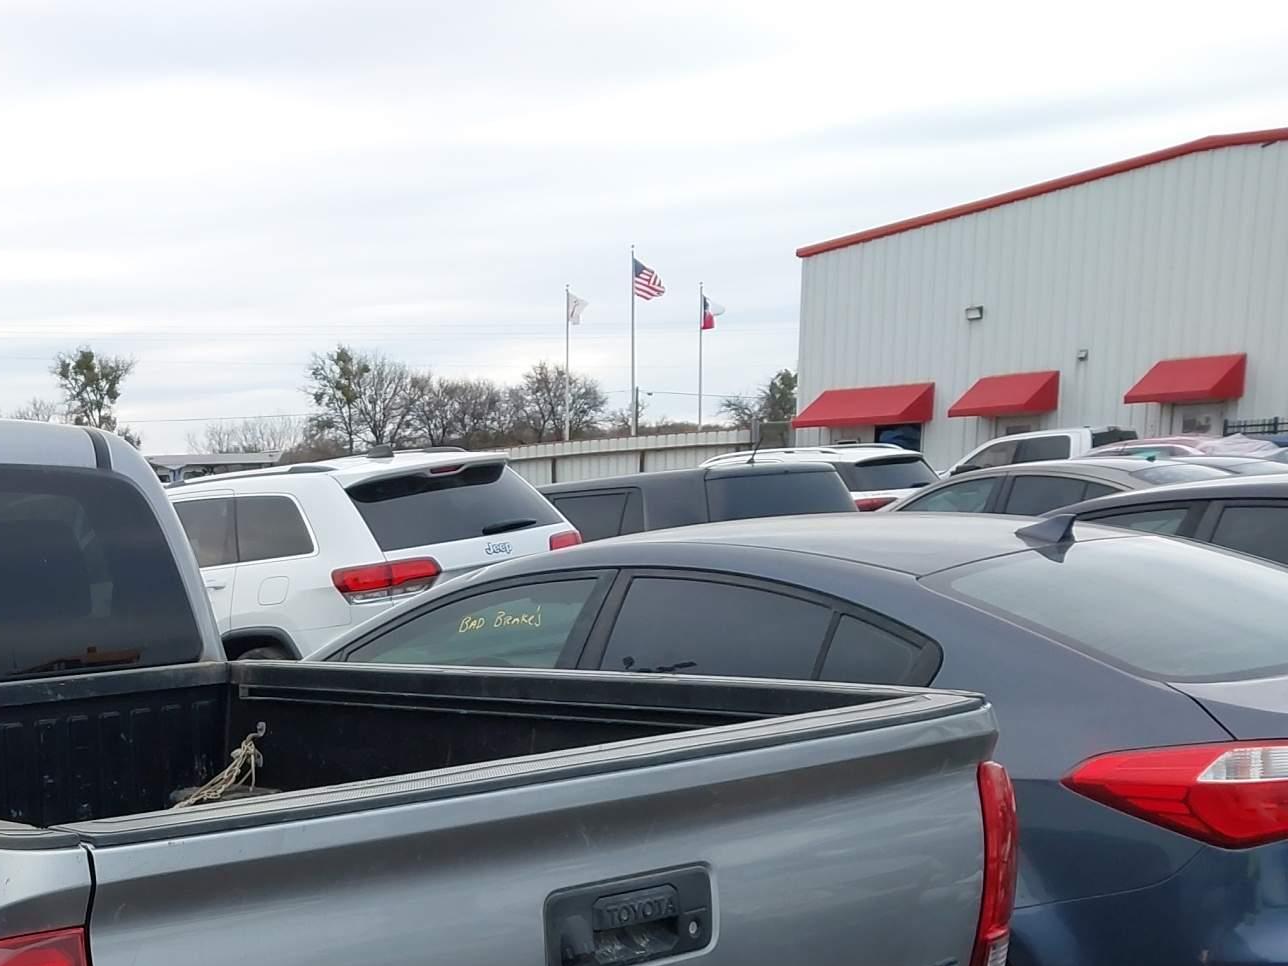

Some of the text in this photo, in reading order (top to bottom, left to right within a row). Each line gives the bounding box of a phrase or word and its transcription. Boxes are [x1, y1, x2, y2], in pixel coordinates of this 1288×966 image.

[484, 541, 513, 556] Jeep
[458, 616, 486, 633] BAD
[606, 897, 676, 924] TOYOTA
